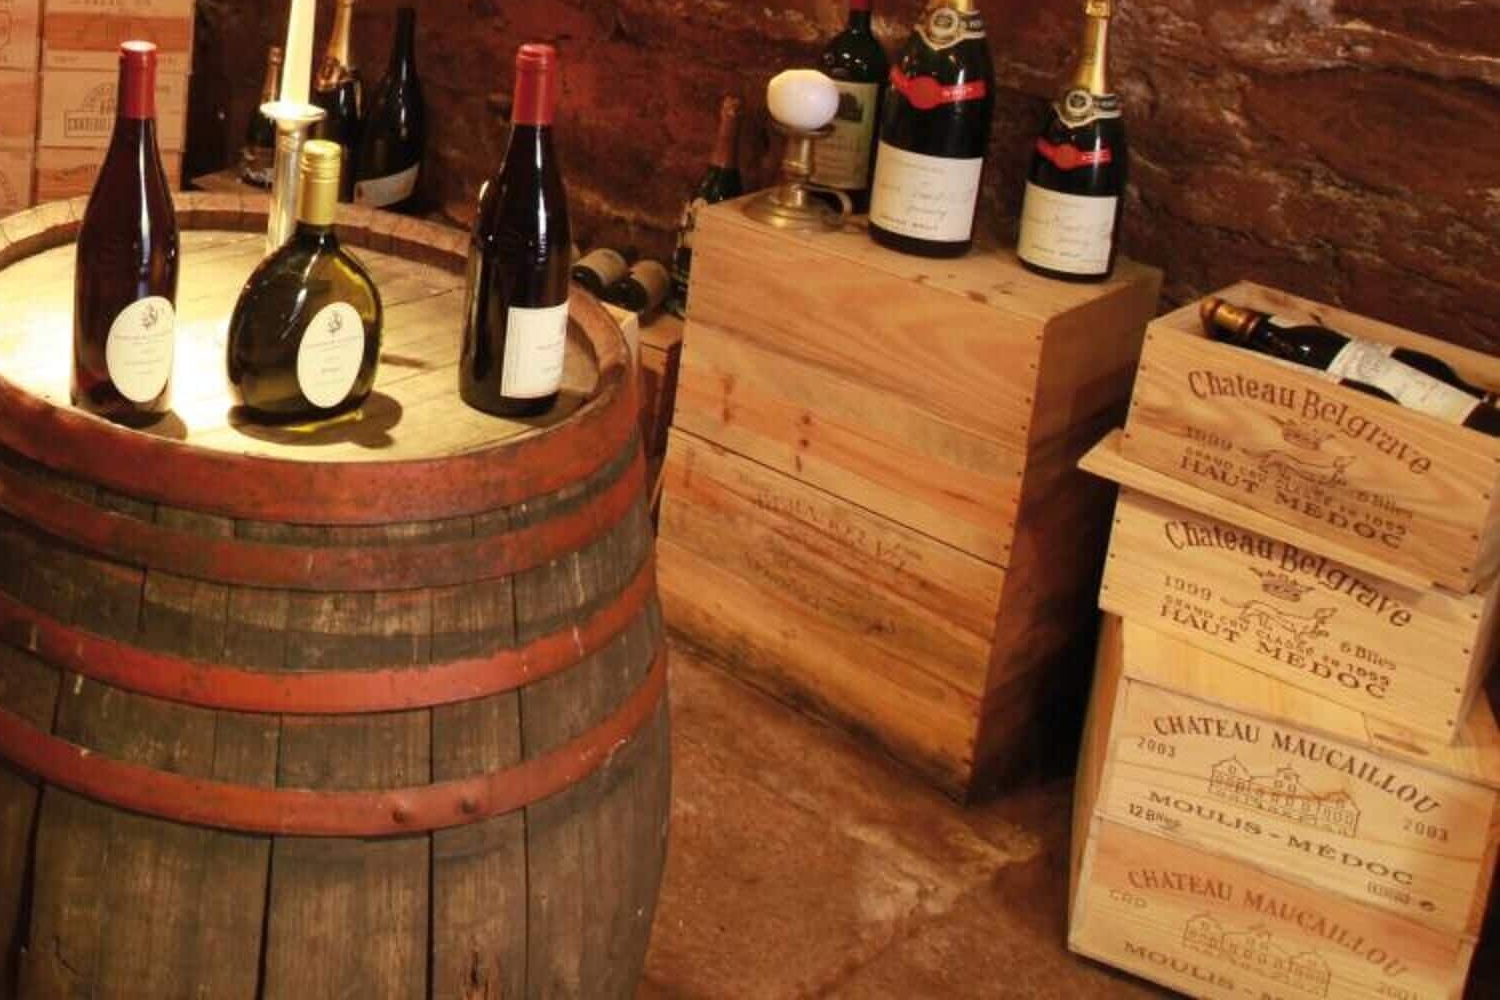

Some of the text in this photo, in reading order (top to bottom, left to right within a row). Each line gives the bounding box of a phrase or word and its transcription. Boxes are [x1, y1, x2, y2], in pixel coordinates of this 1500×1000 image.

[1187, 370, 1296, 411] Chateau
[1299, 389, 1432, 476] Belgrave
[1179, 455, 1261, 494] HAUT
[1164, 521, 1413, 628] Chateau Belgrave
[1163, 594, 1215, 619] GRAND
[1219, 614, 1250, 633] CRU
[1158, 603, 1387, 700] HAUT MEDOC
[1136, 735, 1177, 759] 2003
[1153, 714, 1442, 814] CHATEAU MAUCAILLOU
[1148, 790, 1263, 836] MOULIS
[1402, 818, 1449, 842] 2003
[1126, 868, 1234, 903] CHATEAU
[1243, 888, 1409, 978] MAUCAILLOU
[1122, 940, 1236, 992] MOULIS
